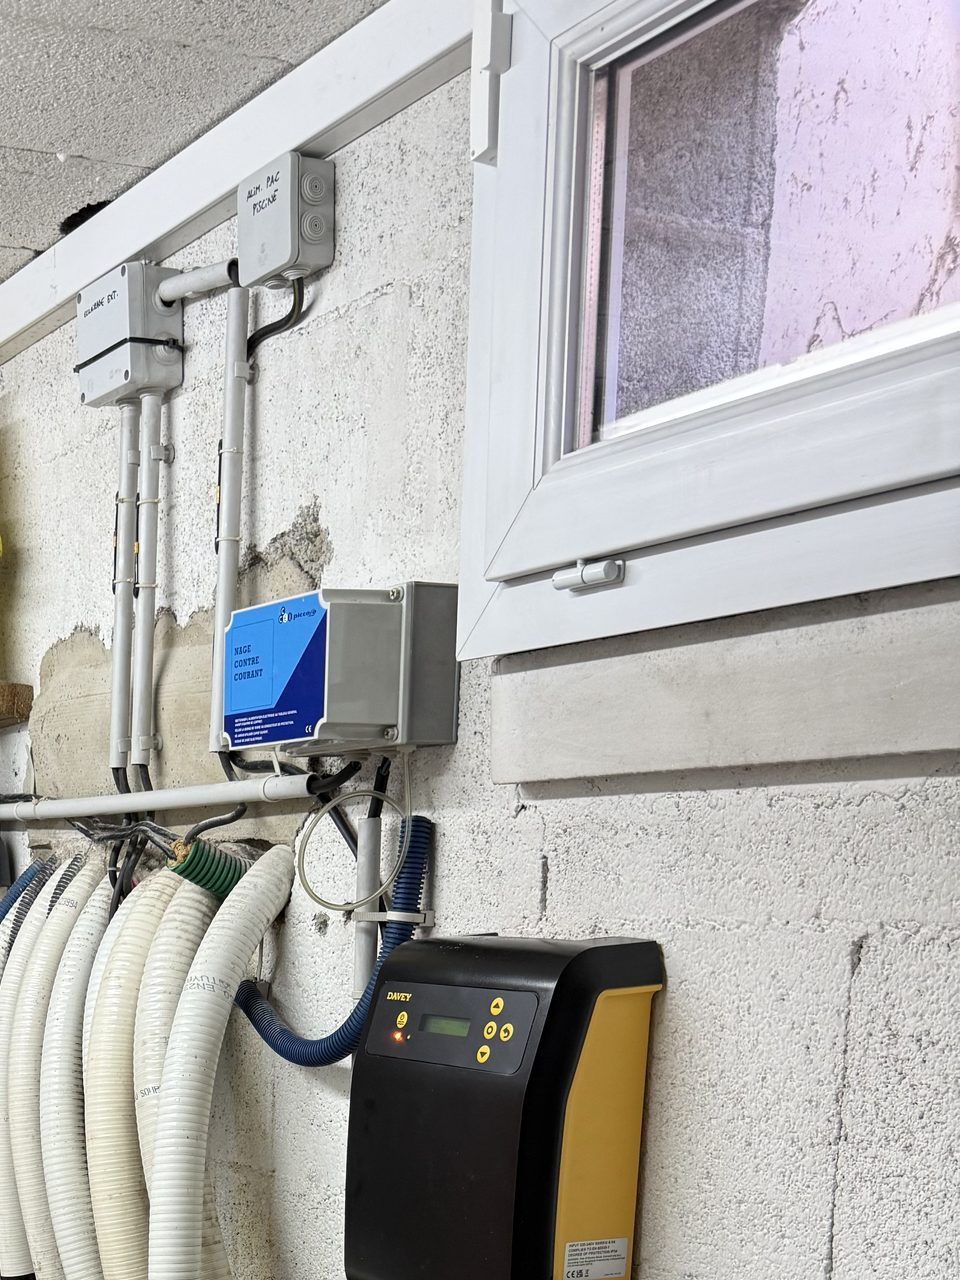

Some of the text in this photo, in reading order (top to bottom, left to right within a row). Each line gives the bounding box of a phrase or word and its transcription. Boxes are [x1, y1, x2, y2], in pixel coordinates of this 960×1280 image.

[266, 170, 280, 189] PAC
[234, 644, 251, 656] NAGE
[234, 656, 260, 669] CONTRE
[234, 668, 263, 681] COURANT
[386, 991, 413, 1002] DAVEY
